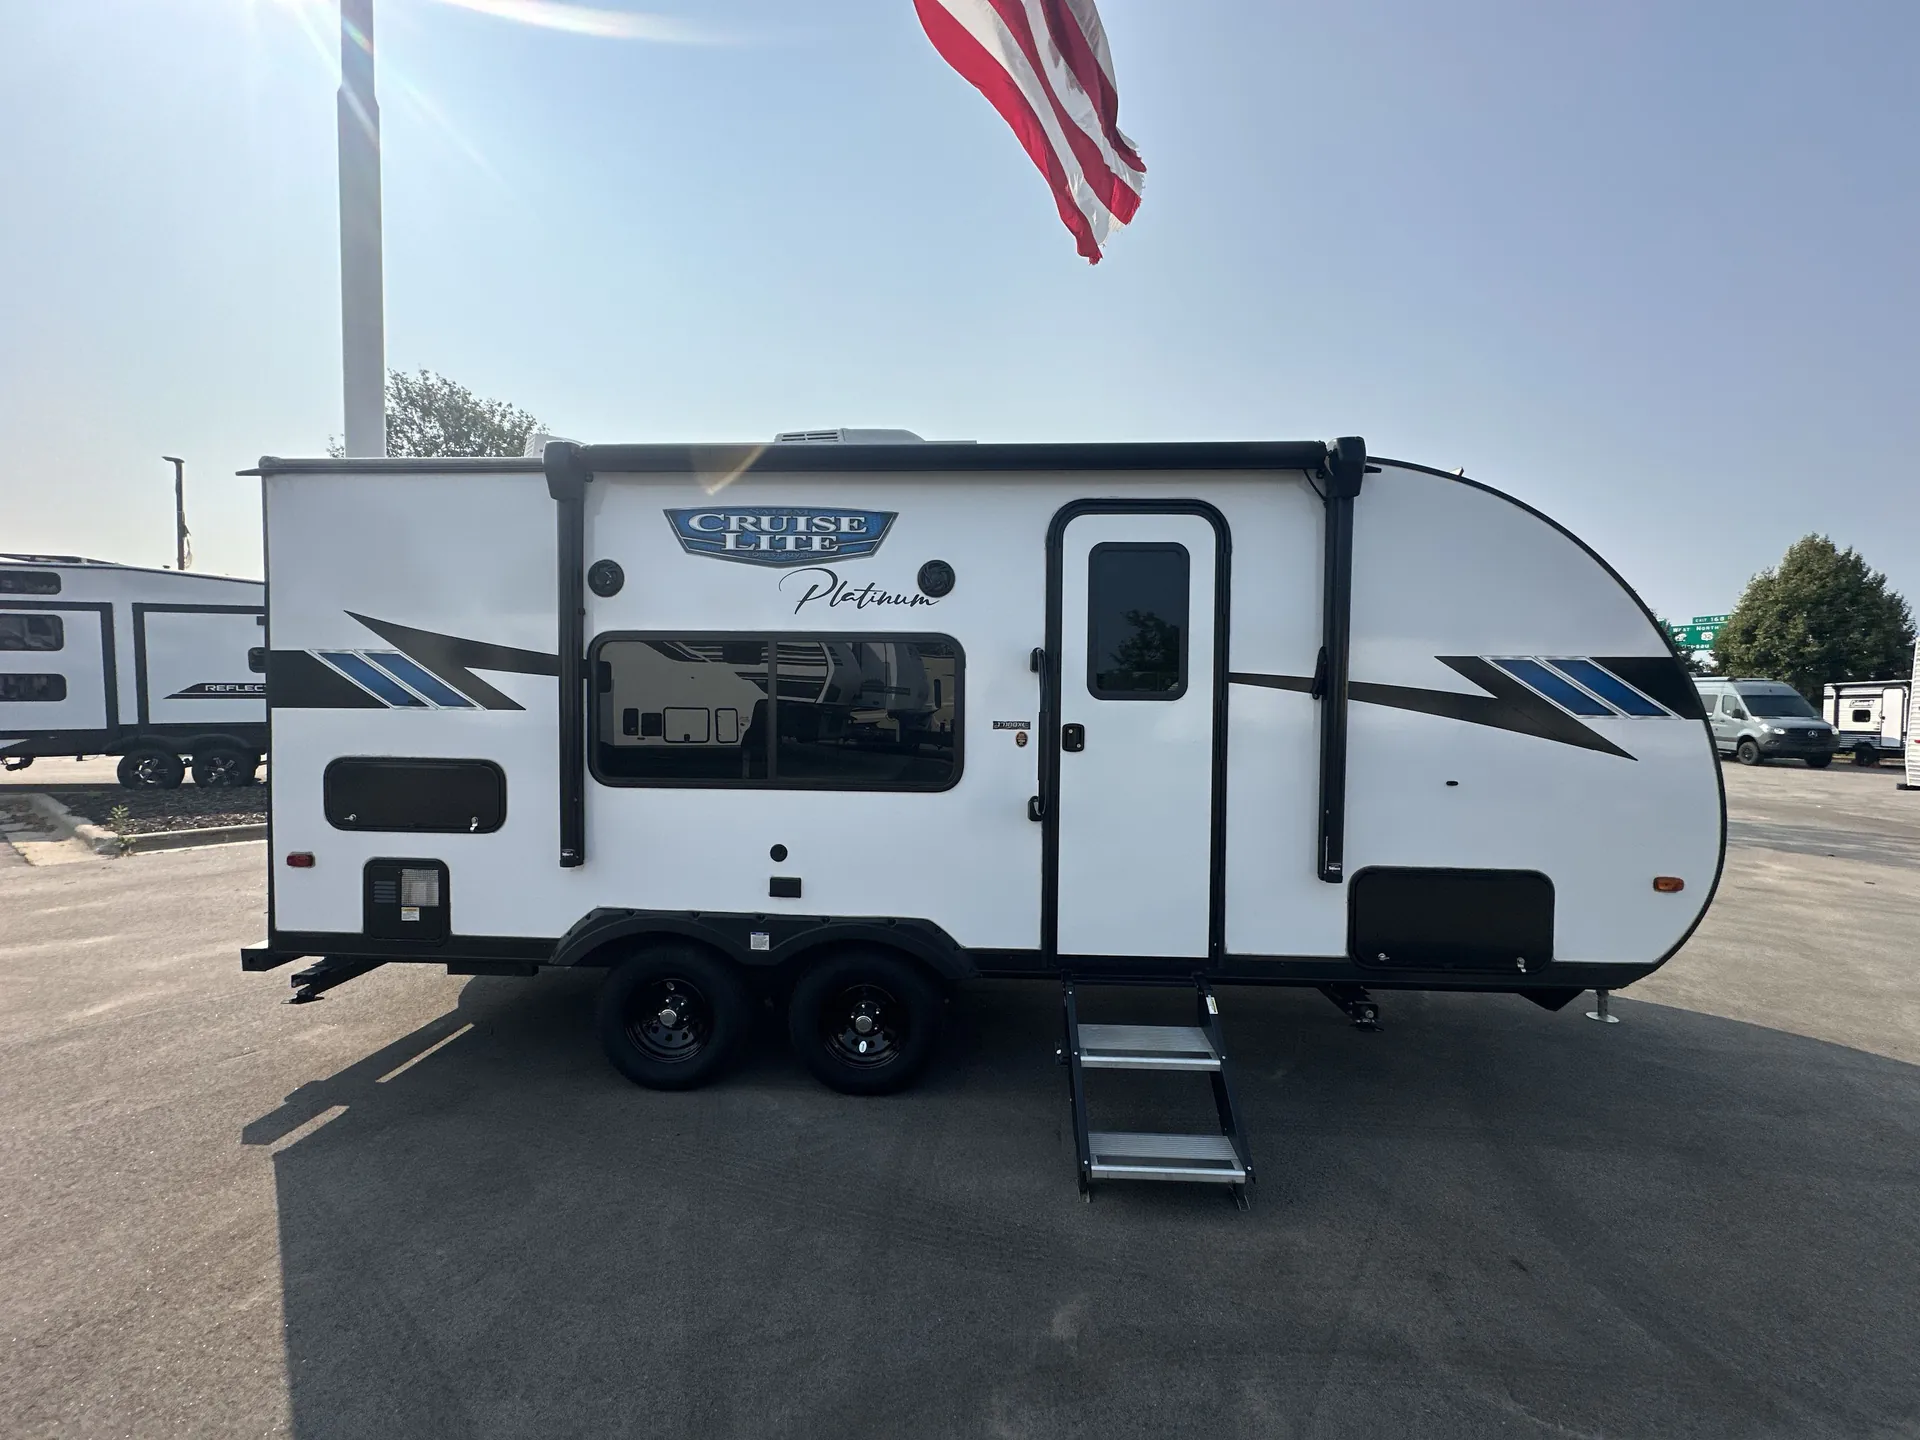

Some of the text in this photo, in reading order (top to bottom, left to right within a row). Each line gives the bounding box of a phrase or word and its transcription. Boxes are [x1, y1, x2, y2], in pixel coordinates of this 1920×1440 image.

[688, 513, 867, 533] CRUISE
[720, 532, 839, 552] LITE
[778, 567, 940, 615] Platinum
[205, 684, 266, 692] REFLEC
